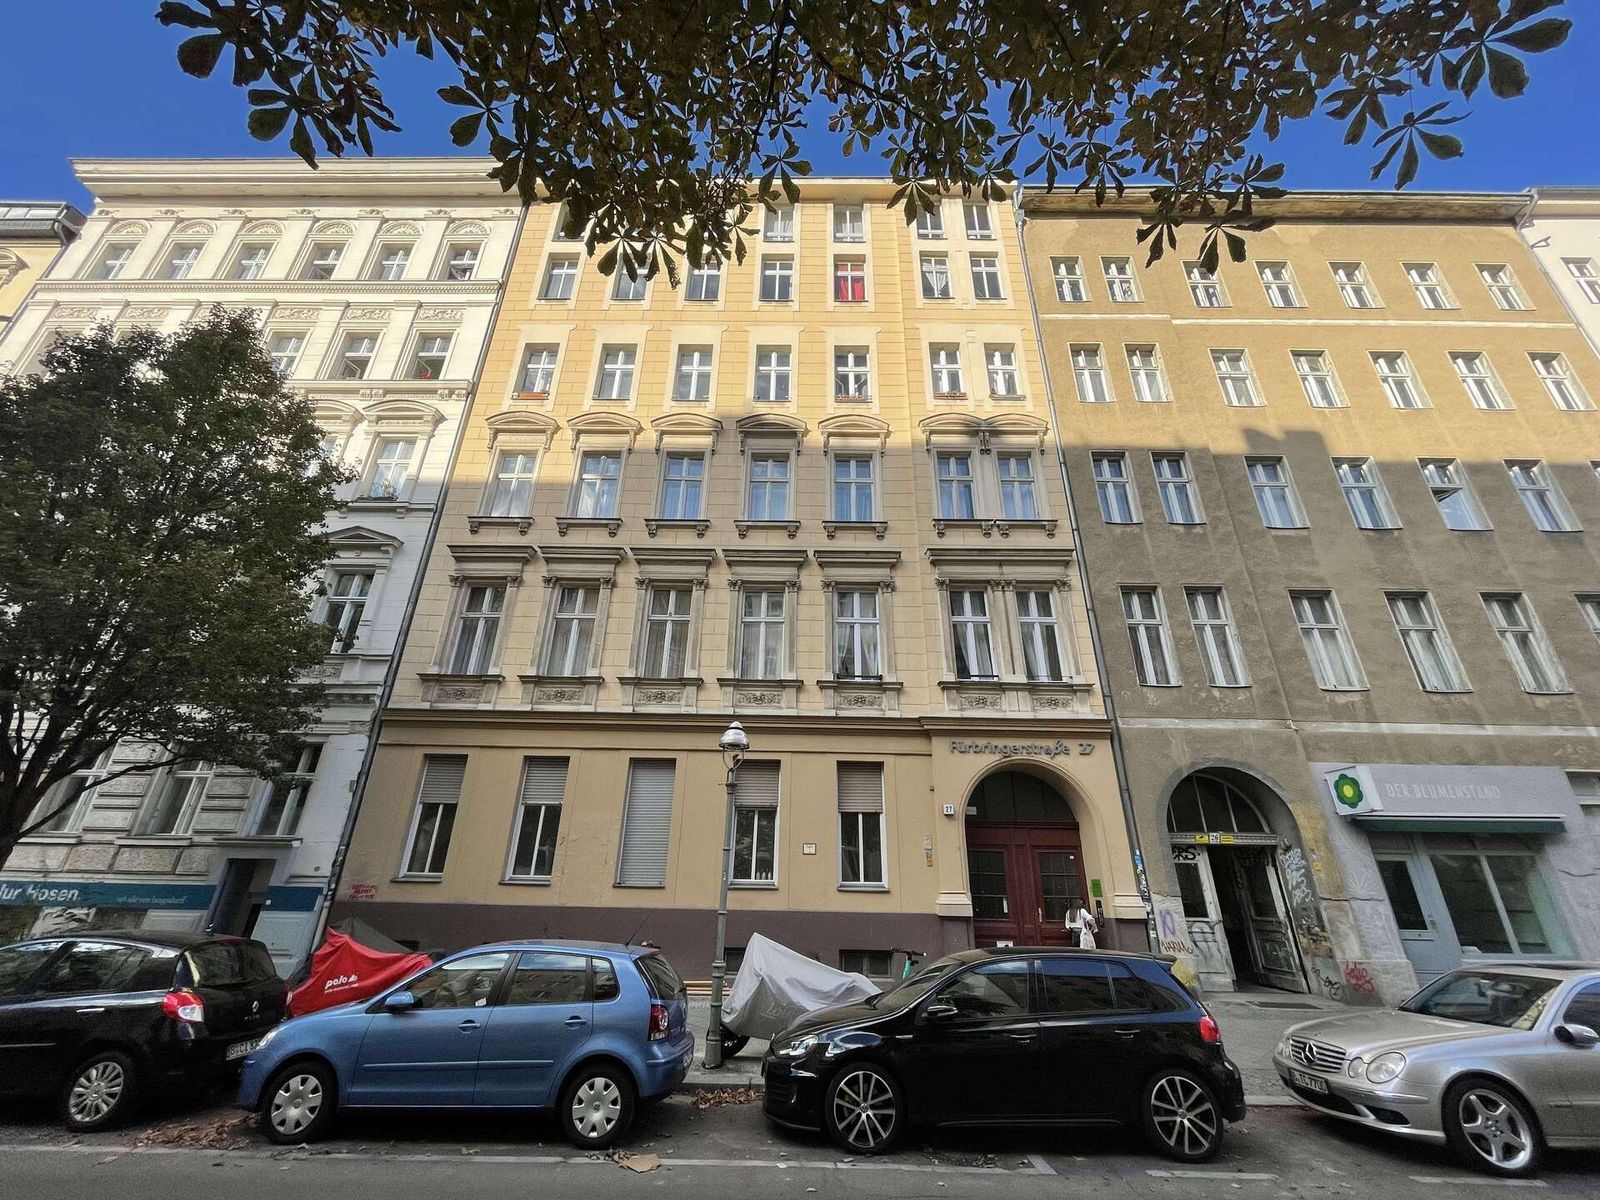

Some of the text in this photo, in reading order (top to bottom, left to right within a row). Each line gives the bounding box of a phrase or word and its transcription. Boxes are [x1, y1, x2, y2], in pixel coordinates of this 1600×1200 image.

[950, 739, 1095, 759] Fürbringerstraße 27
[1386, 783, 1501, 800] DER BLUMENSTAND
[945, 805, 953, 813] 27
[324, 975, 348, 989] polo
